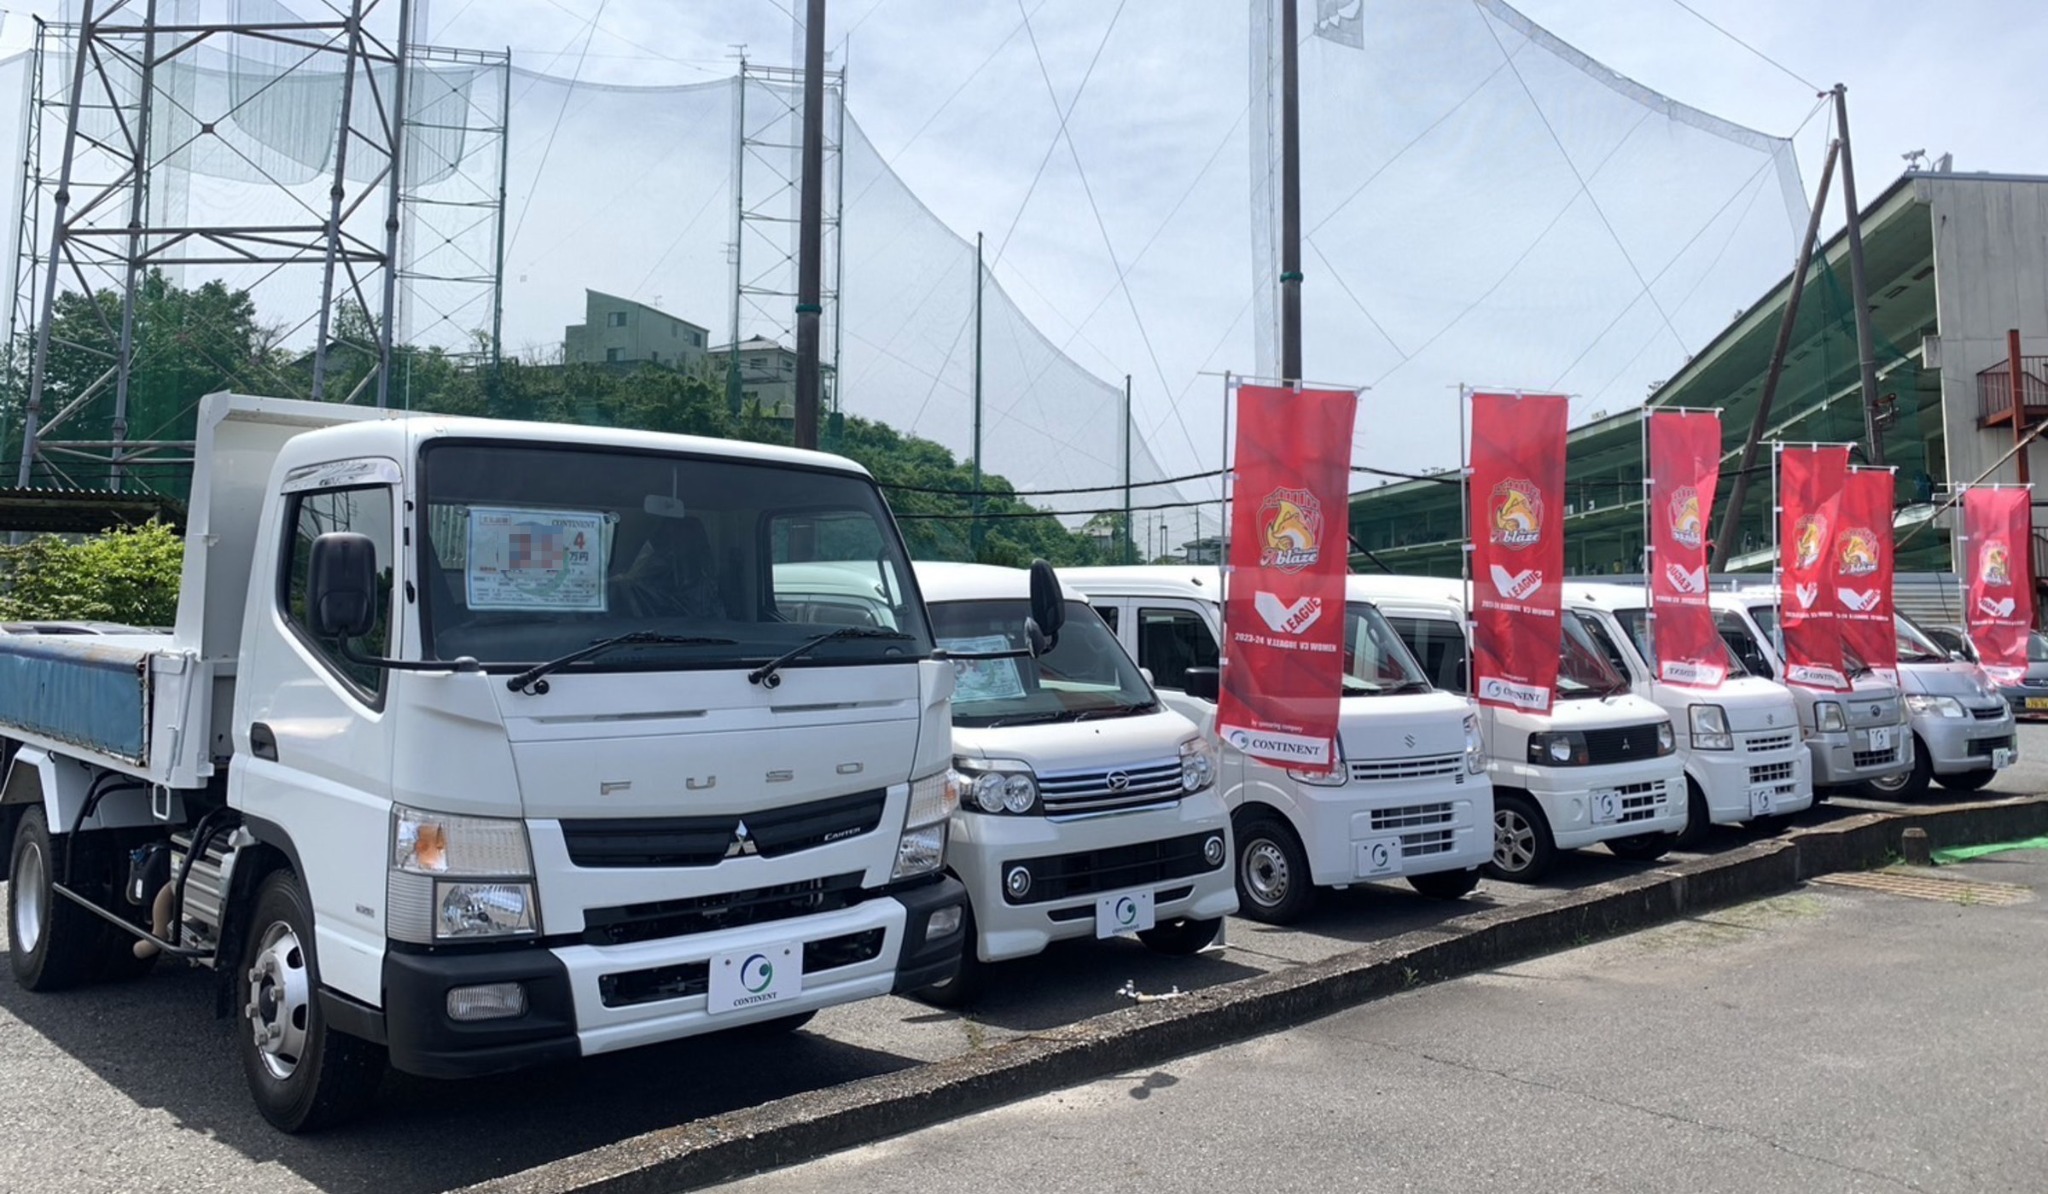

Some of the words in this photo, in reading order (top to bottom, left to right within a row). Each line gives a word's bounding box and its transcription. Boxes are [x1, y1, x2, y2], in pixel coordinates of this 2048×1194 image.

[552, 519, 595, 528] CONTINENT
[573, 531, 585, 550] 4
[569, 551, 589, 562] 万円
[1260, 548, 1318, 567] Ablaze
[1507, 570, 1542, 598] LEAGUE
[1281, 597, 1322, 634] LEAGUE
[1252, 738, 1320, 756] CONTINENT
[600, 762, 864, 796] FUSO
[733, 992, 778, 1007] CONTINENT
